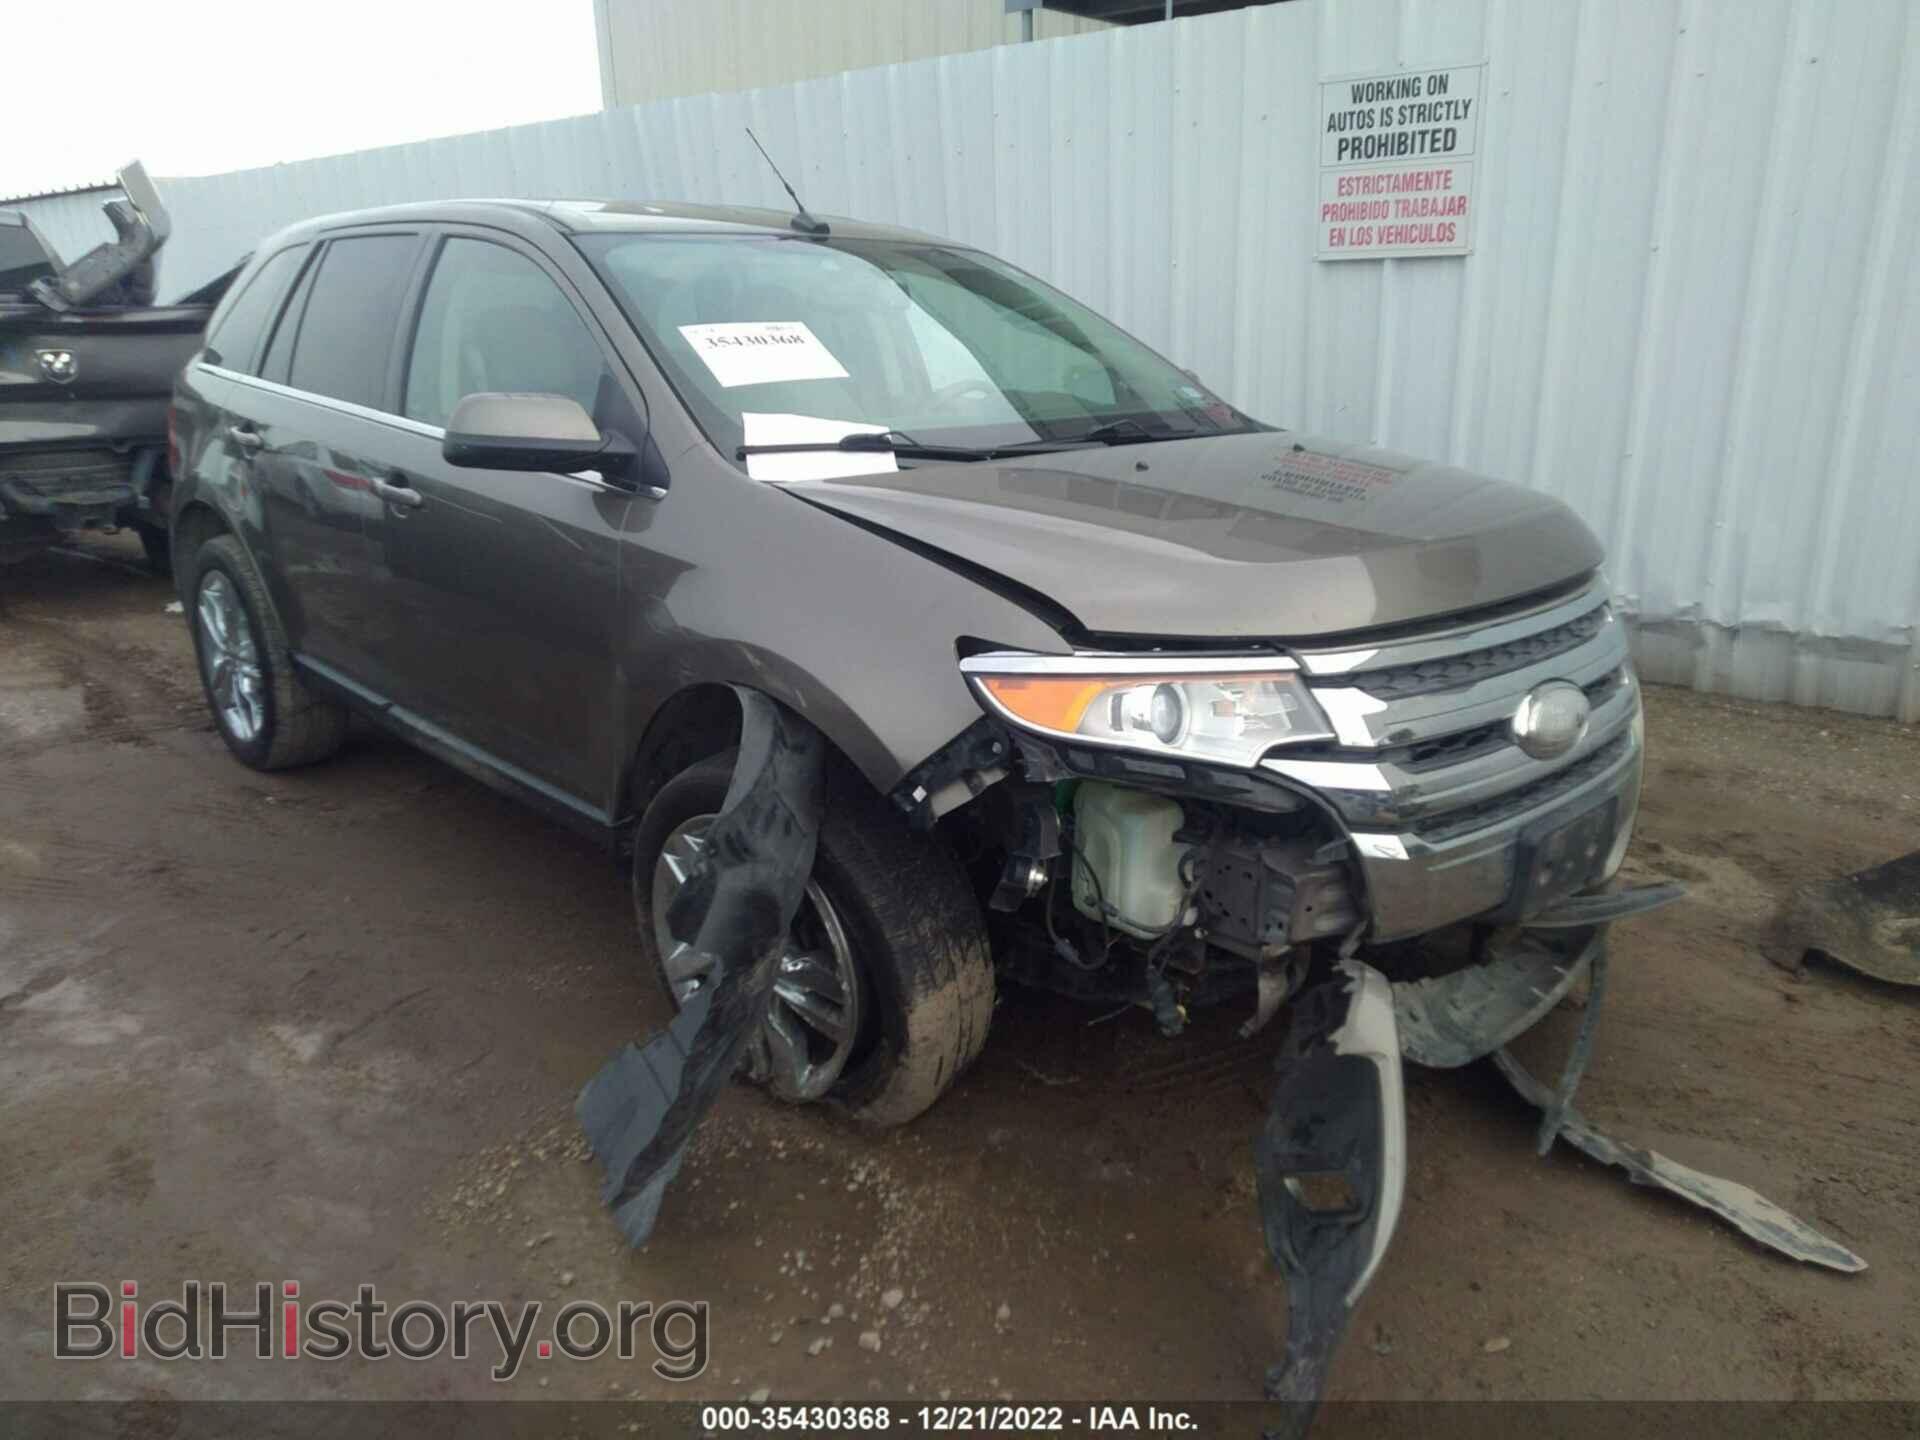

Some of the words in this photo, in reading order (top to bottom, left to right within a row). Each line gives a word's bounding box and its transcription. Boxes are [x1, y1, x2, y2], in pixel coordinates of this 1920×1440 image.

[1352, 77, 1421, 104] WORKING
[1427, 74, 1449, 95] ON
[1327, 109, 1375, 133] AUTOS
[1380, 107, 1394, 127] IS
[1398, 99, 1472, 126] STRICTLY
[1337, 127, 1457, 161] PROHIBITED
[1337, 170, 1453, 197] ESTRICTAMENTE
[1321, 200, 1389, 223] PROHIBIDO
[1395, 196, 1467, 219] TRABAJAR
[1329, 228, 1346, 248] EN
[1350, 226, 1373, 246] LOS
[1378, 222, 1457, 245] VEHICULOS
